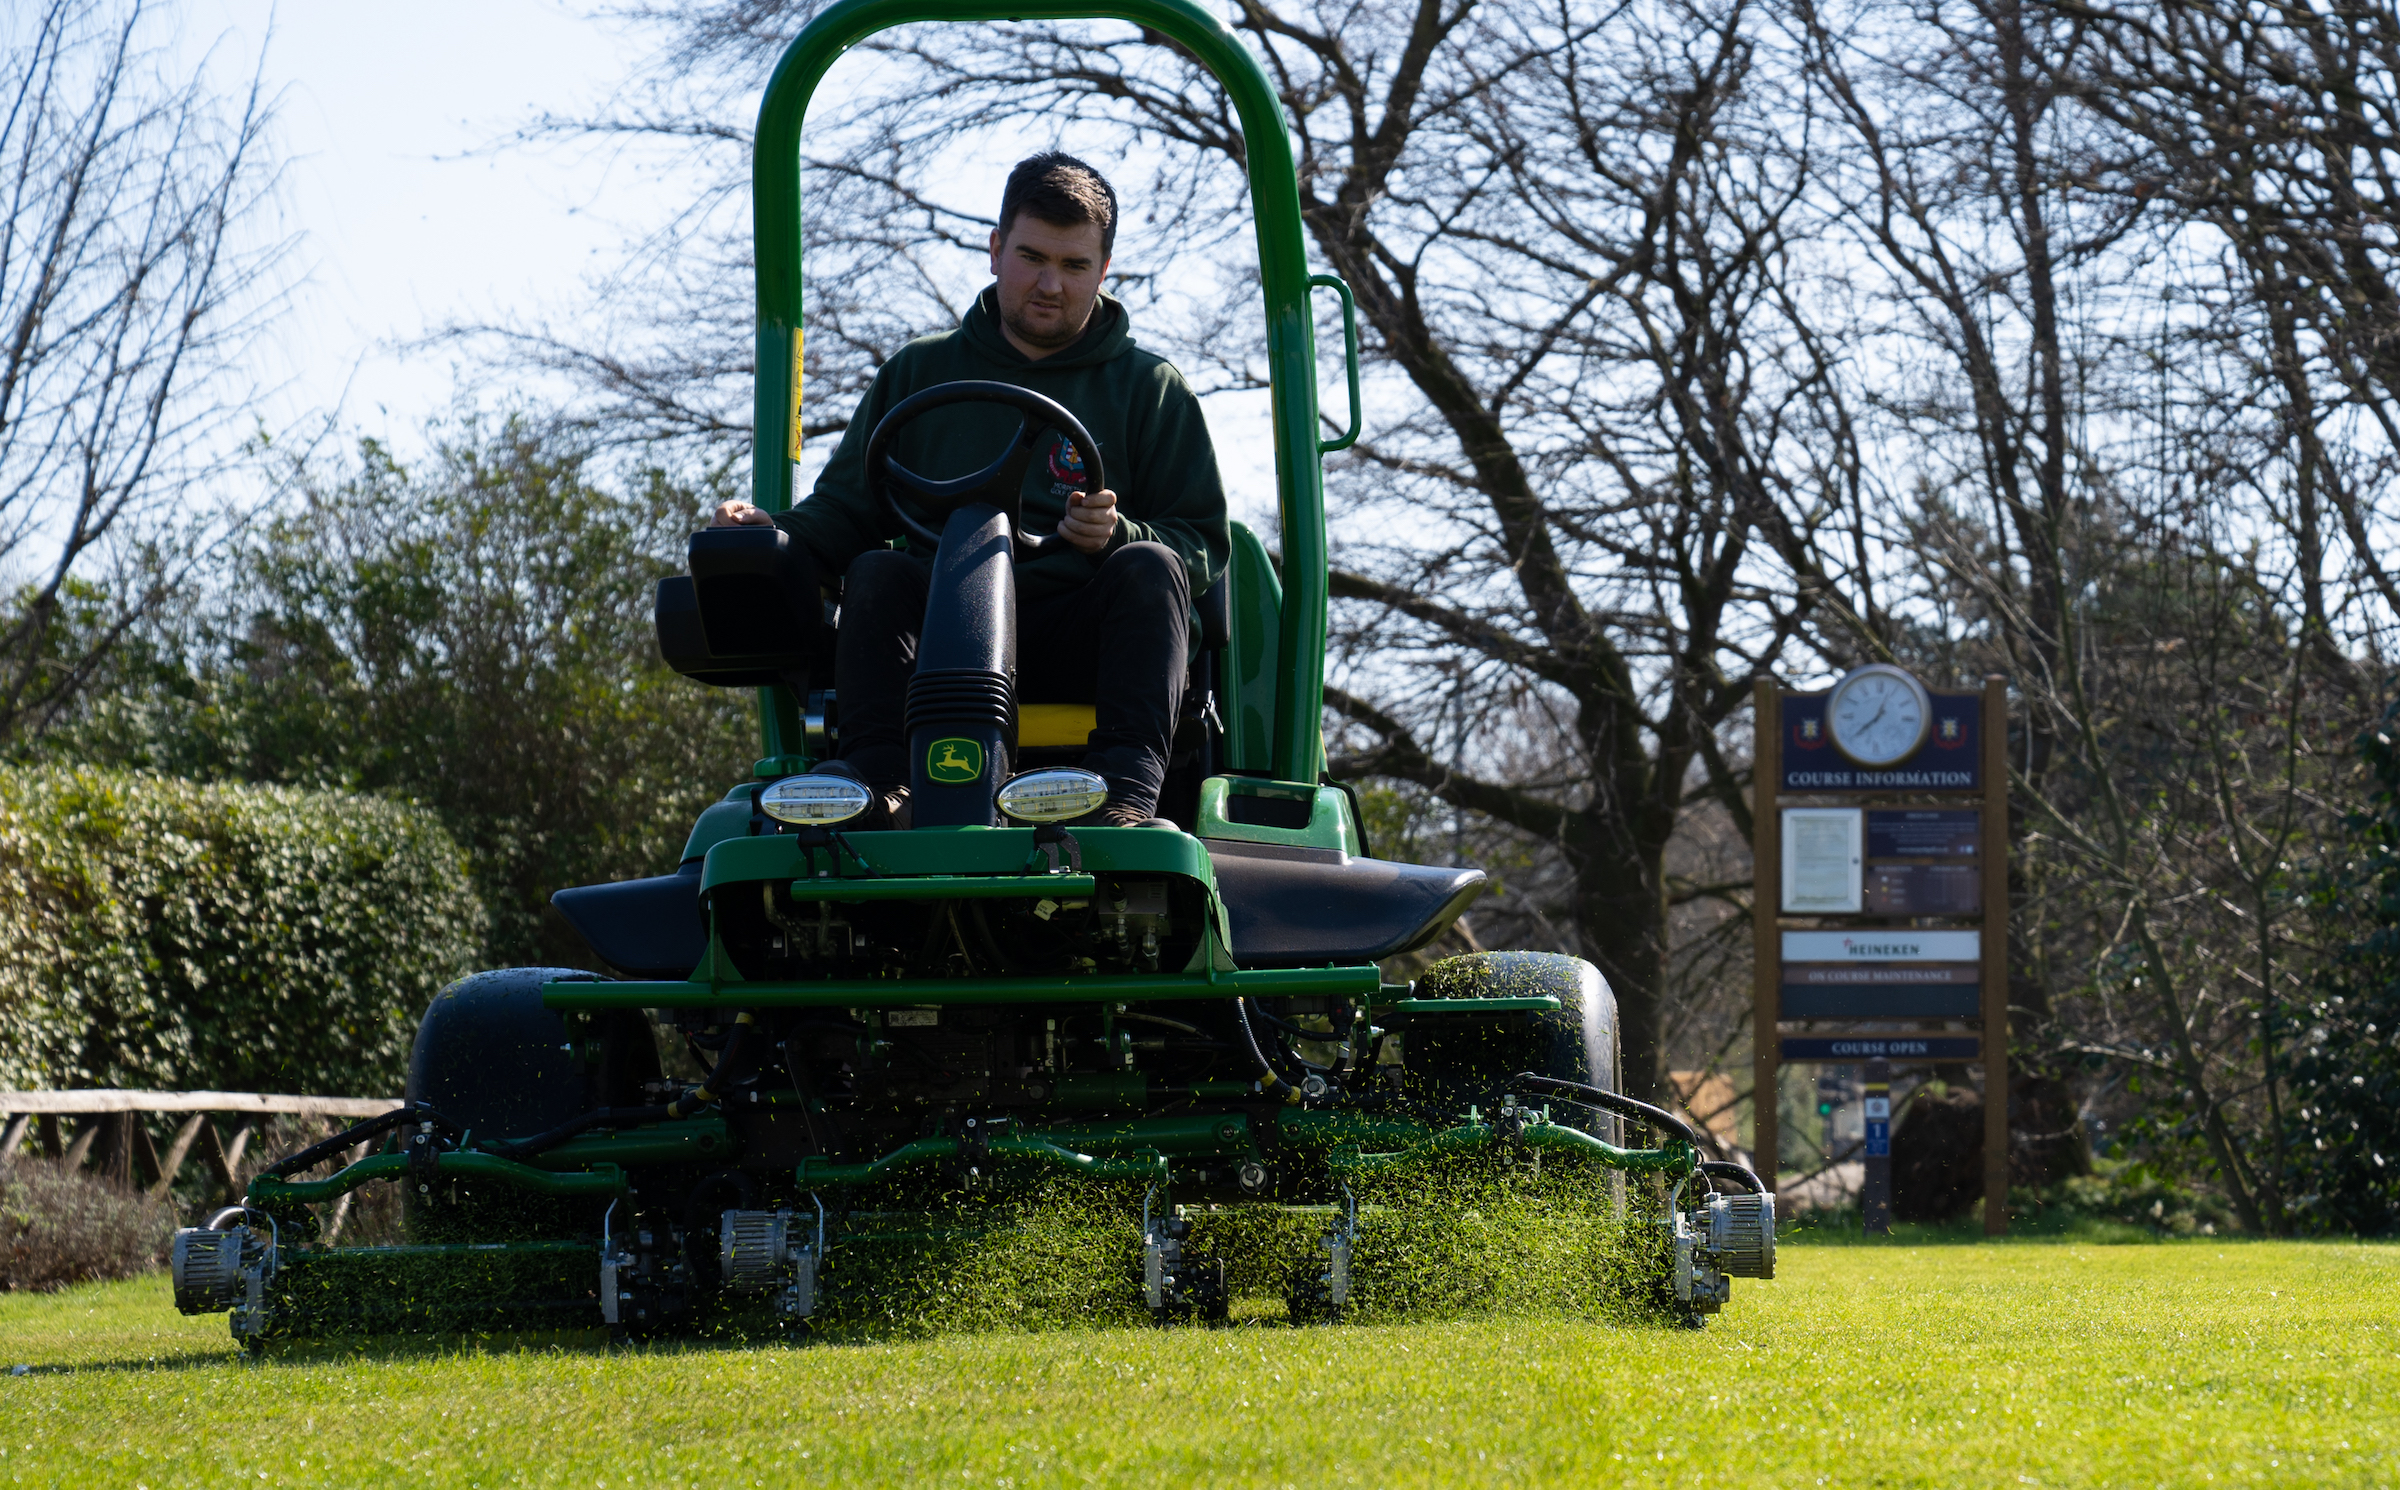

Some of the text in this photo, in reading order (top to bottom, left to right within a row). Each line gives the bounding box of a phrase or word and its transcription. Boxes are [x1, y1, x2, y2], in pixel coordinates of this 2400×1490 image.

[1050, 487, 1066, 496] GOLF
[1788, 771, 1972, 786] COURSE INFORMATION
[1849, 944, 1920, 956] HEINEKEN
[1808, 970, 1952, 981] ON COURSE MAINTENANCE
[1831, 1041, 1928, 1055] COURSE OPEN
[1873, 1123, 1881, 1138] 1
